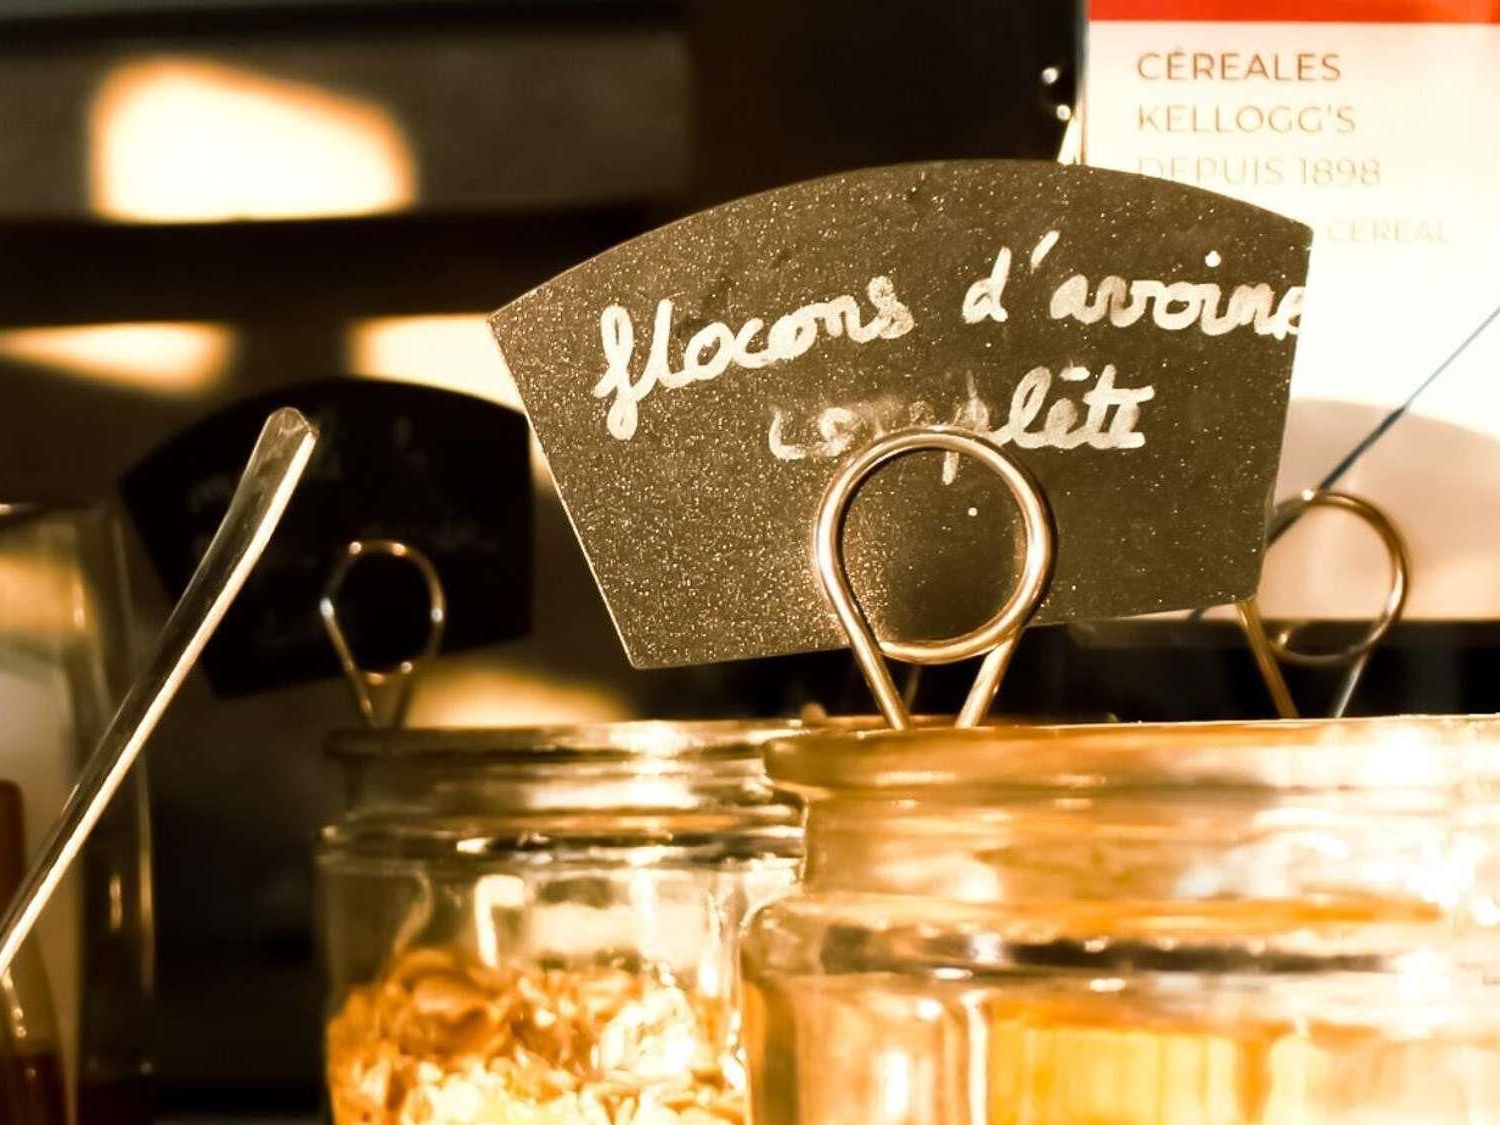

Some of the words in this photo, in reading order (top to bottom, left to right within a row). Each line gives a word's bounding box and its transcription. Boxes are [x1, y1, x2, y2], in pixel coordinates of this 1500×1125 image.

[1137, 47, 1342, 82] CÉREALES
[1137, 104, 1357, 134] KELLOGG'S
[1137, 157, 1285, 186] DEPUIS
[1299, 157, 1381, 187] 1898
[593, 275, 915, 441] flocons
